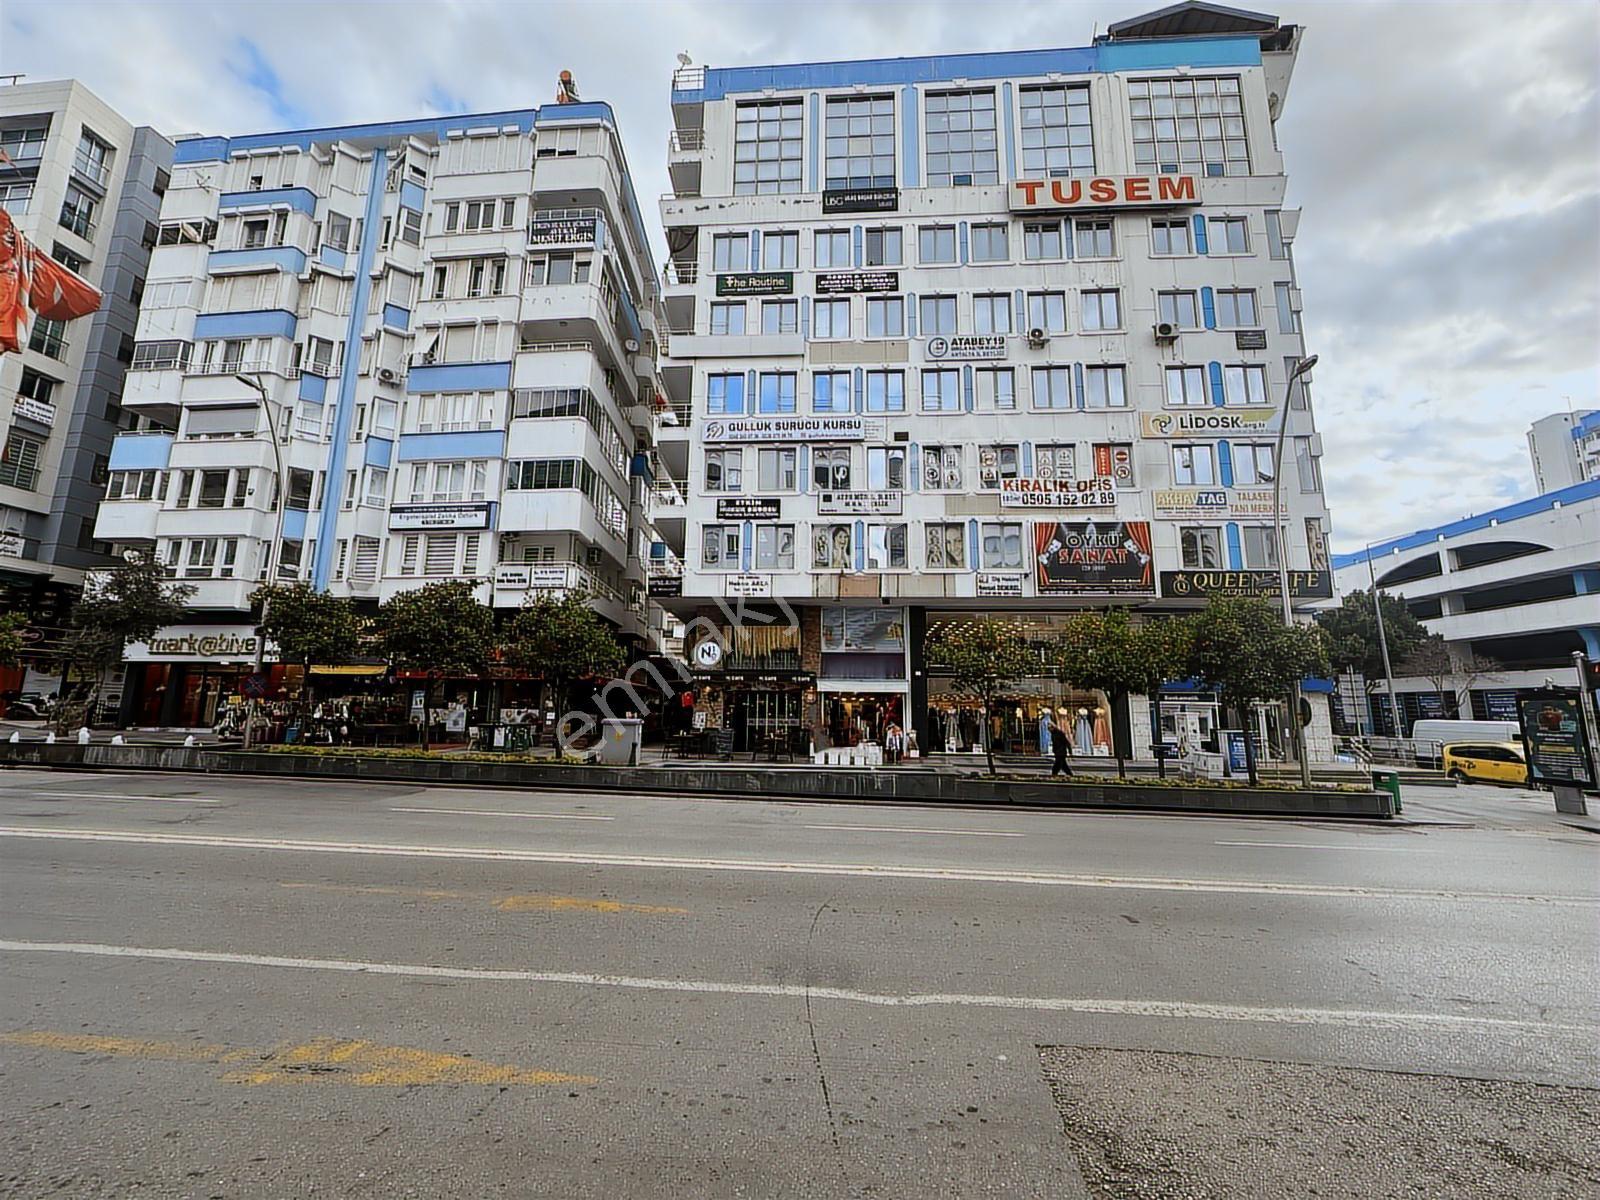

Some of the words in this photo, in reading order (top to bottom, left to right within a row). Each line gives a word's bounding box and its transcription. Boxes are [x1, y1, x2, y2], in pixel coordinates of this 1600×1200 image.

[1015, 176, 1196, 205] TUSEM
[823, 419, 861, 430] KURSU
[1076, 478, 1113, 492] OFİS
[1021, 493, 1051, 505] 0505
[1056, 493, 1078, 505] 152
[1081, 492, 1097, 504] 02
[1099, 491, 1115, 504] 89
[1058, 548, 1128, 564] SANAT
